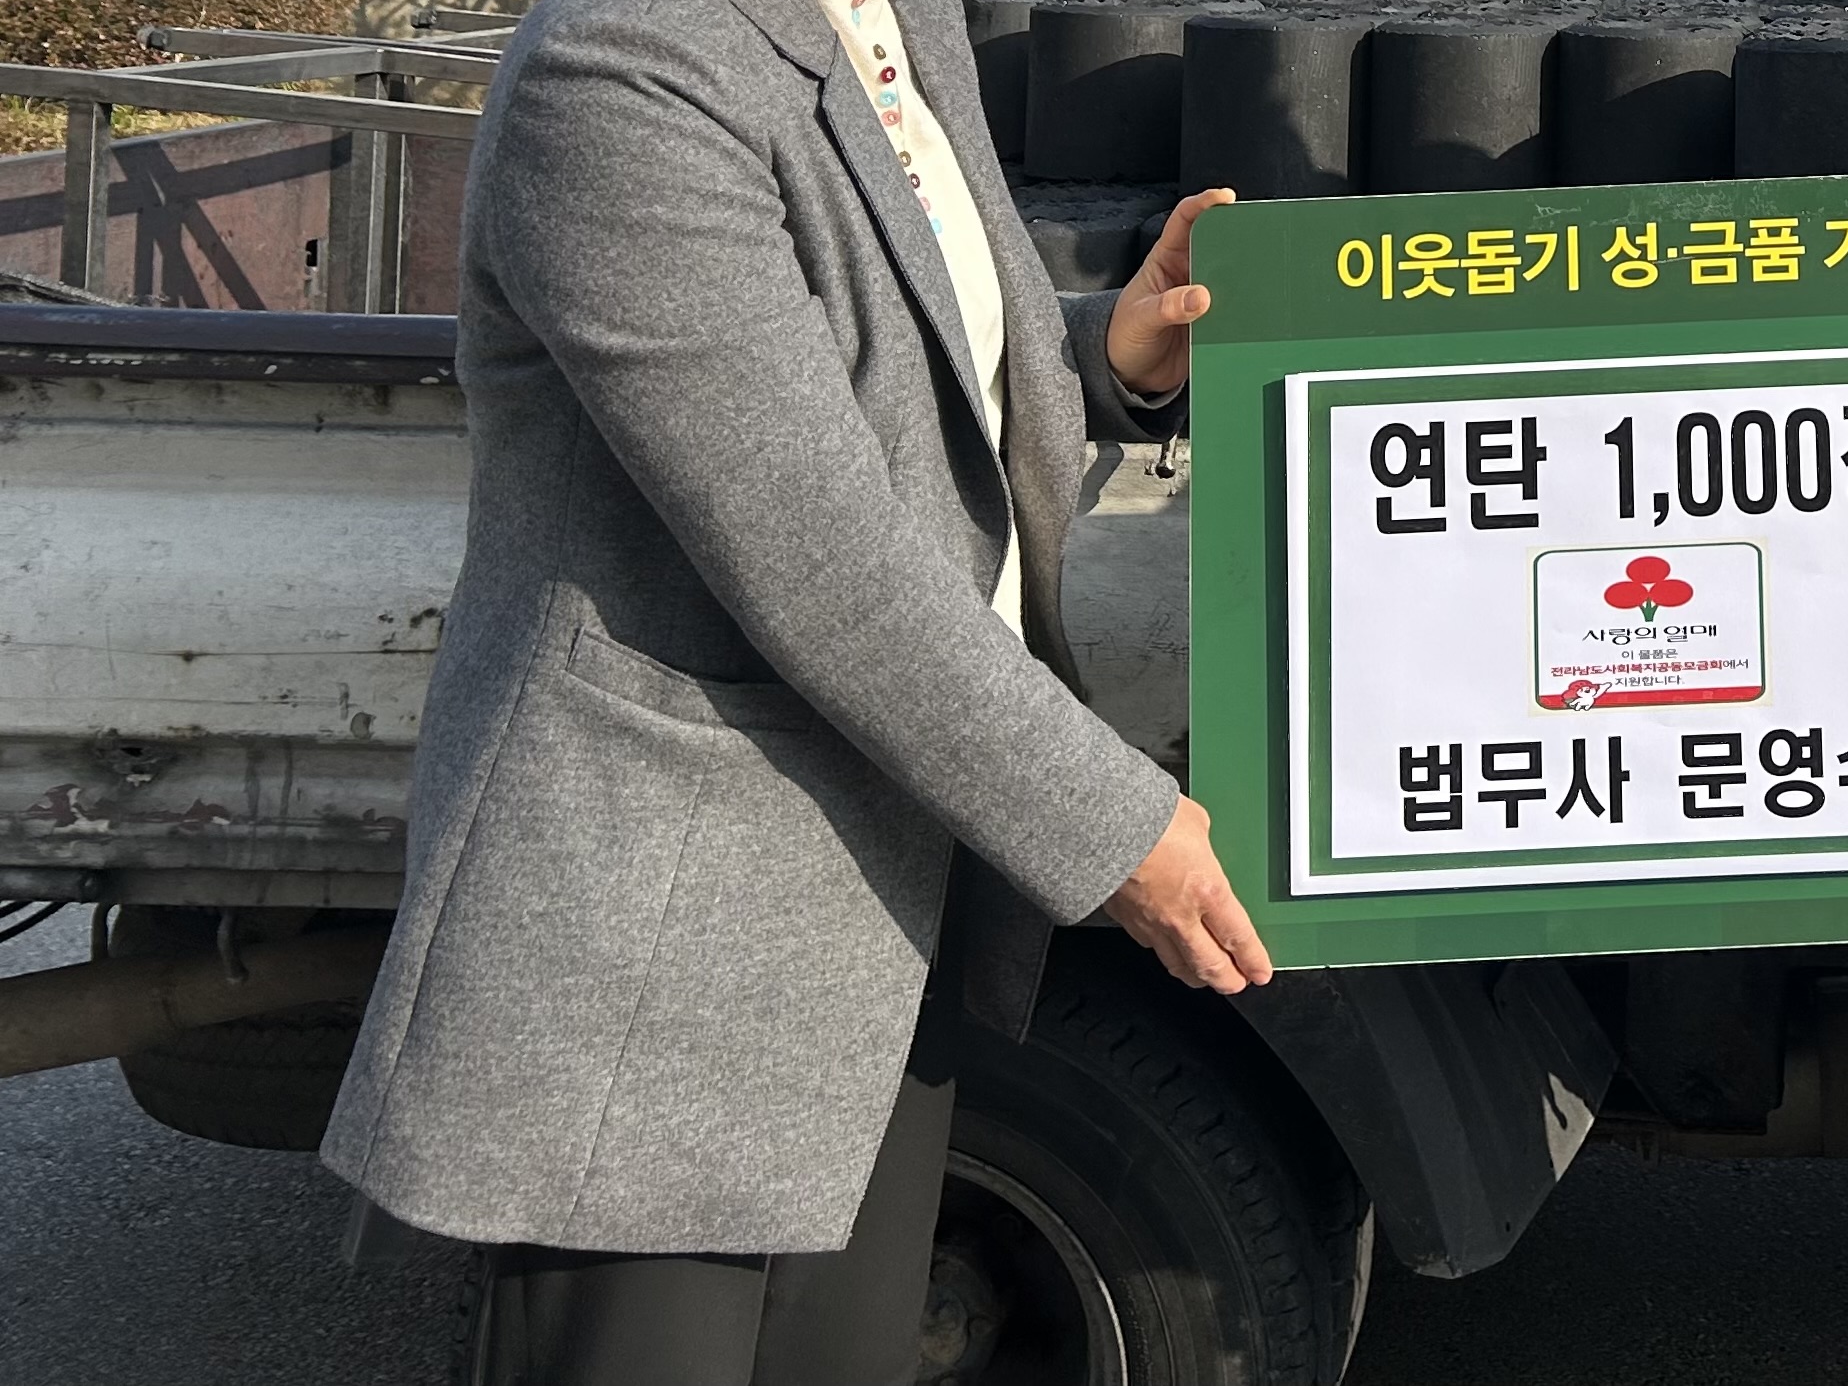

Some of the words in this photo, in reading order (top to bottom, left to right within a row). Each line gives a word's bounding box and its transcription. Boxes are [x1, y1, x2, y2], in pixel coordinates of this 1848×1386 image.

[1336, 225, 1581, 301] 이웃돕기
[1370, 417, 1546, 534] 연탄
[1582, 627, 1657, 646] 사랑의
[1663, 624, 1717, 643] 열매
[1621, 650, 1634, 661] 이
[1400, 736, 1629, 831] 법무사
